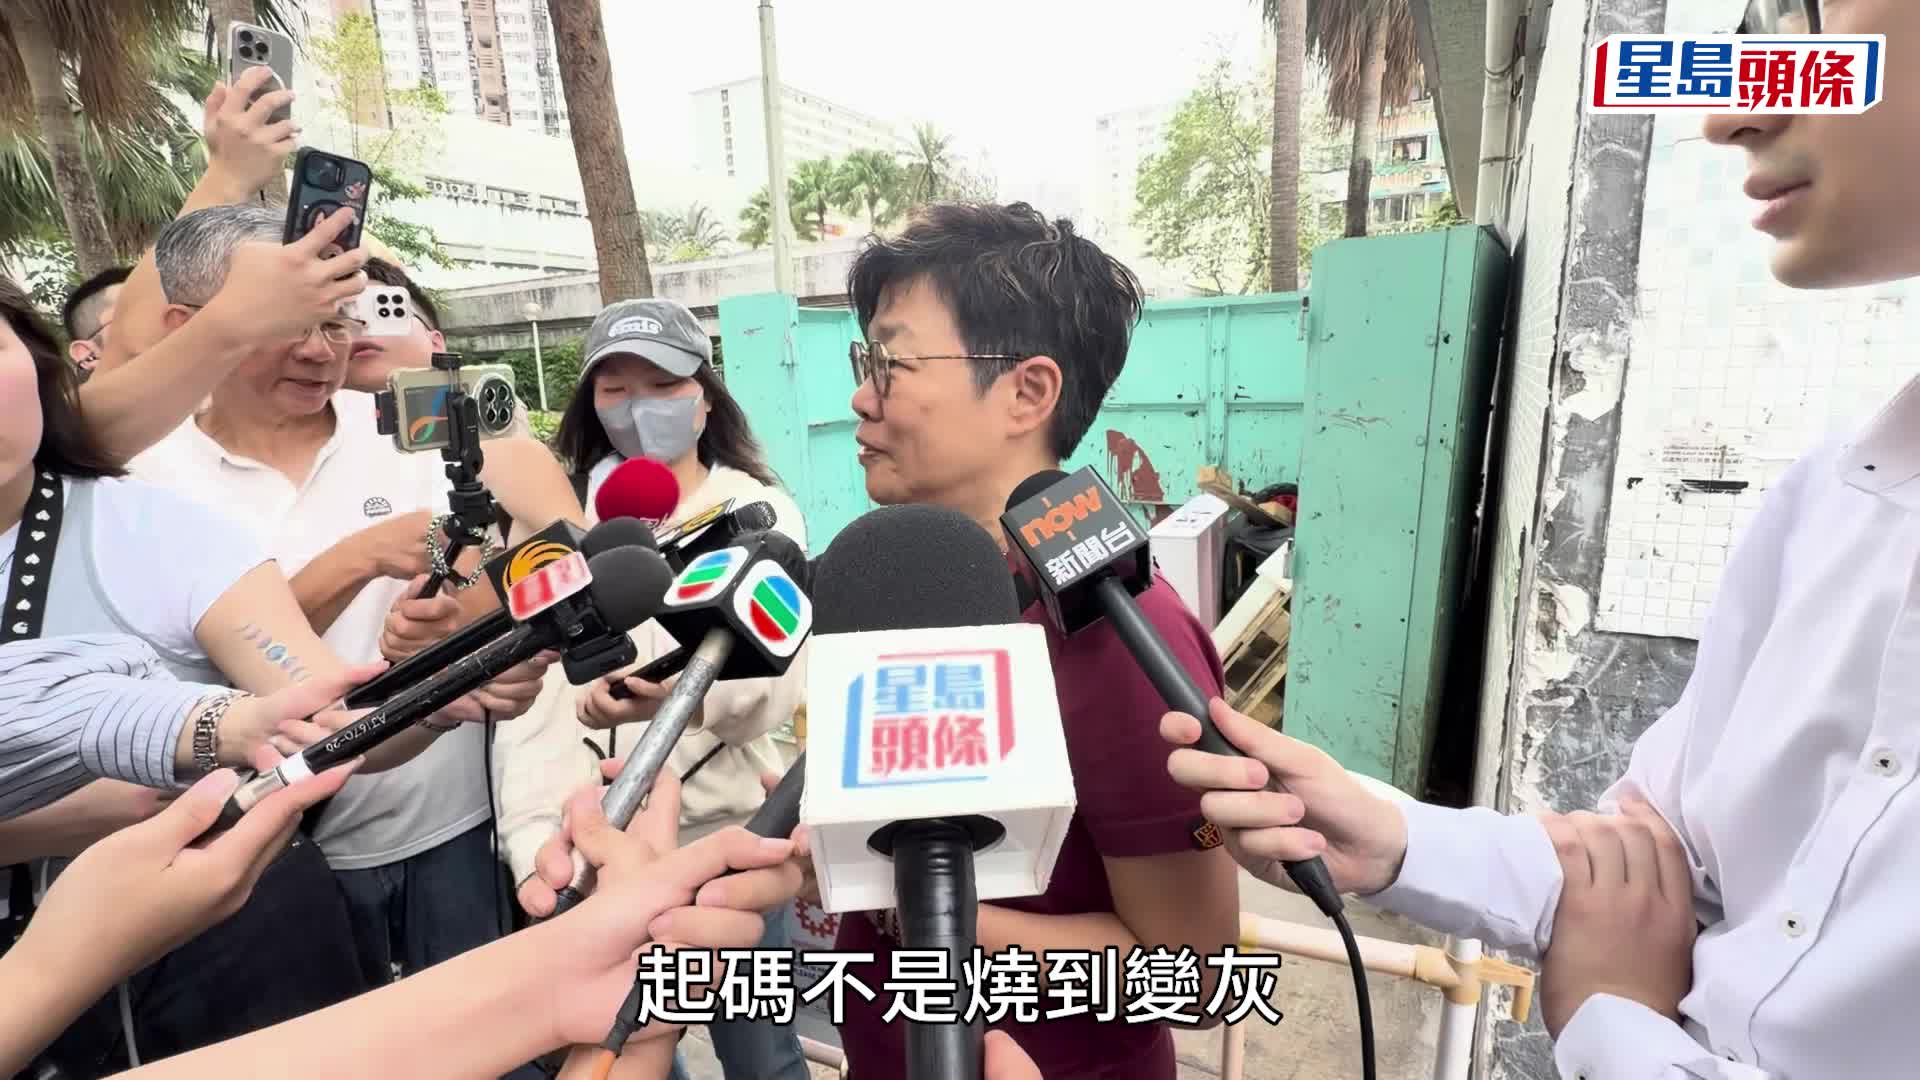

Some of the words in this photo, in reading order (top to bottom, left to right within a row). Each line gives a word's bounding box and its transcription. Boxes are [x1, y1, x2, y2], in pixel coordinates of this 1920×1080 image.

[1020, 486, 1101, 547] now
[1045, 522, 1136, 584] 新聞台
[875, 663, 984, 714] 星島
[869, 714, 986, 776] 頭條
